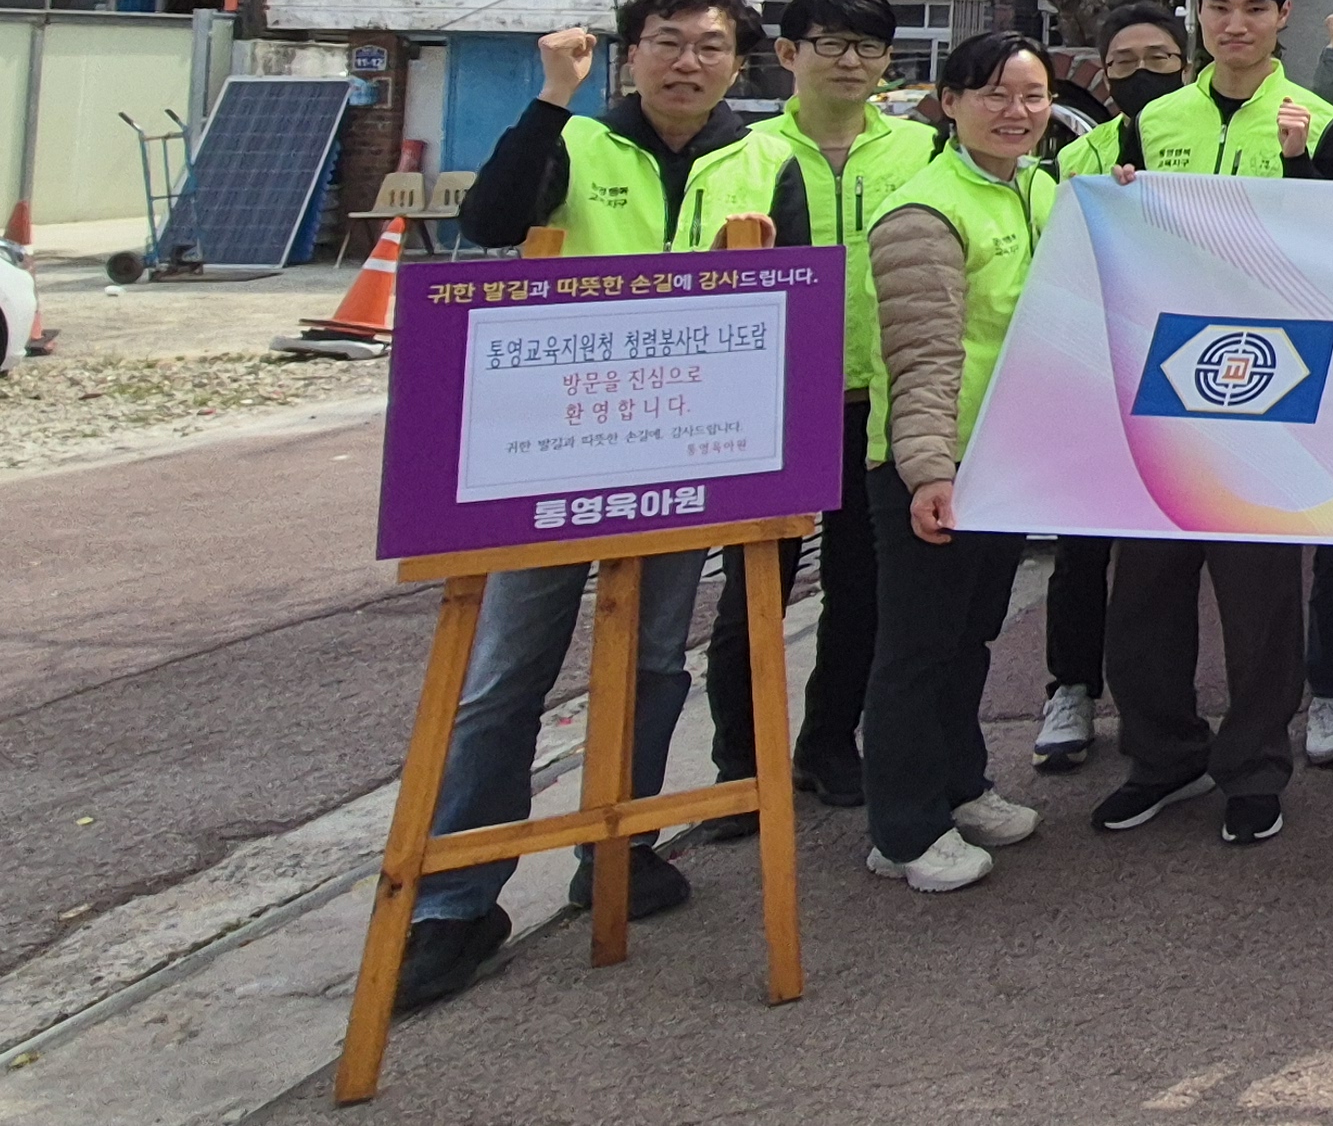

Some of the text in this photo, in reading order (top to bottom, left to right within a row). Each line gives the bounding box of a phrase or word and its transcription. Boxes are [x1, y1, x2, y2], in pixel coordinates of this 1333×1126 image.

[427, 267, 819, 304] 귀한 발길과 따뜻한 손길에 감사드립니다.
[486, 321, 768, 369] 통영교육지원청 청렴봉사단 나도람
[562, 365, 703, 396] 방문을 진심으로
[534, 485, 707, 529] 통영육아원
